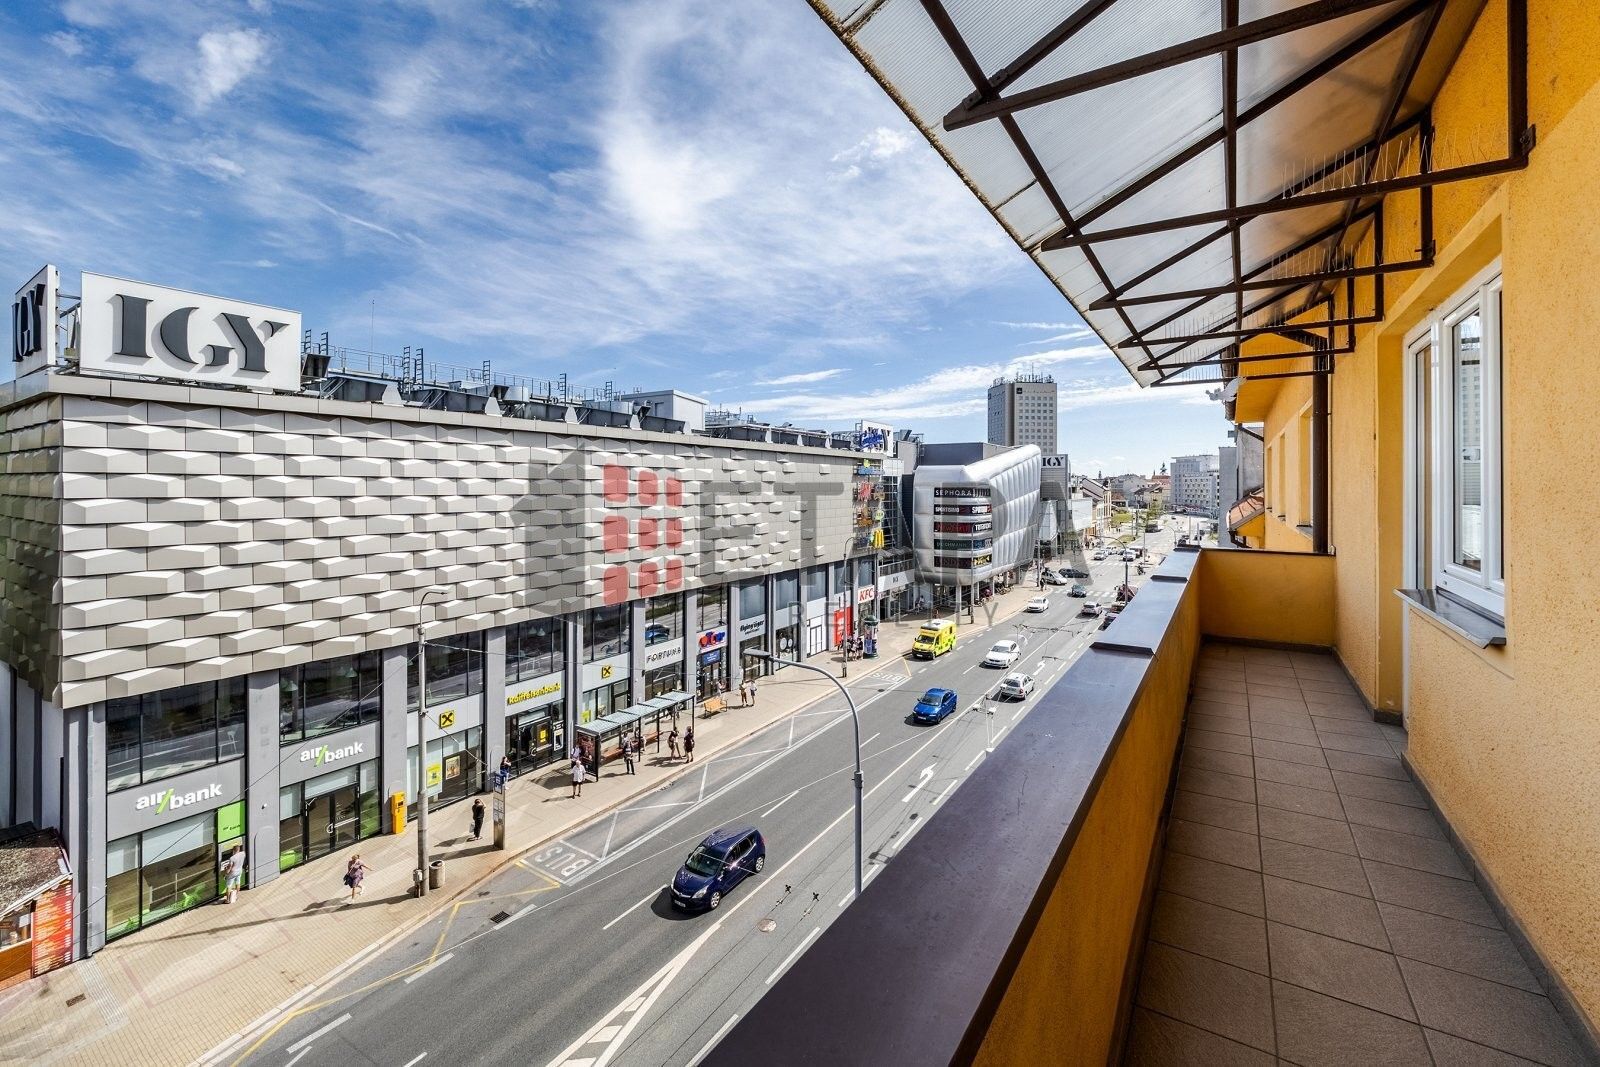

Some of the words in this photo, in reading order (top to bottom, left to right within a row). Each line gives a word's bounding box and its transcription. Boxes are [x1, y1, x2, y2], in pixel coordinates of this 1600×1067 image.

[114, 293, 290, 374] IGY
[1042, 457, 1064, 467] IGY
[859, 588, 875, 601] KFC
[534, 846, 592, 877] BUS
